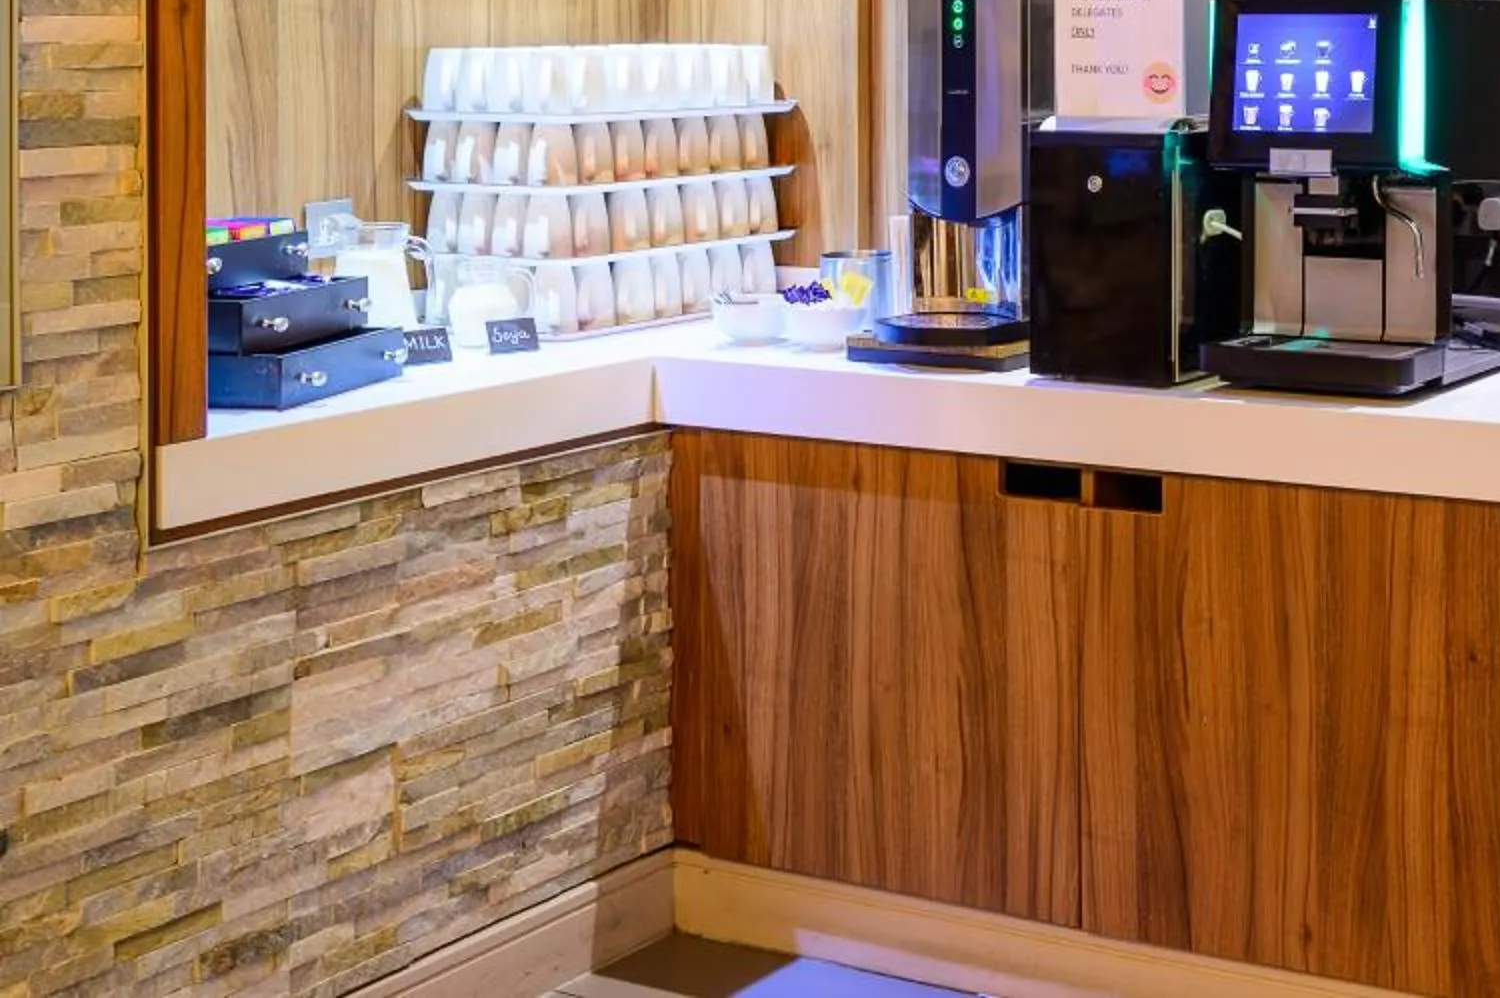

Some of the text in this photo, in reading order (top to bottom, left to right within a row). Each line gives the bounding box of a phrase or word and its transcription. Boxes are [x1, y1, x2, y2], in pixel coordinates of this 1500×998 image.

[1070, 7, 1123, 19] DELEGATES
[1070, 64, 1102, 76] THANK
[403, 334, 446, 352] MILK
